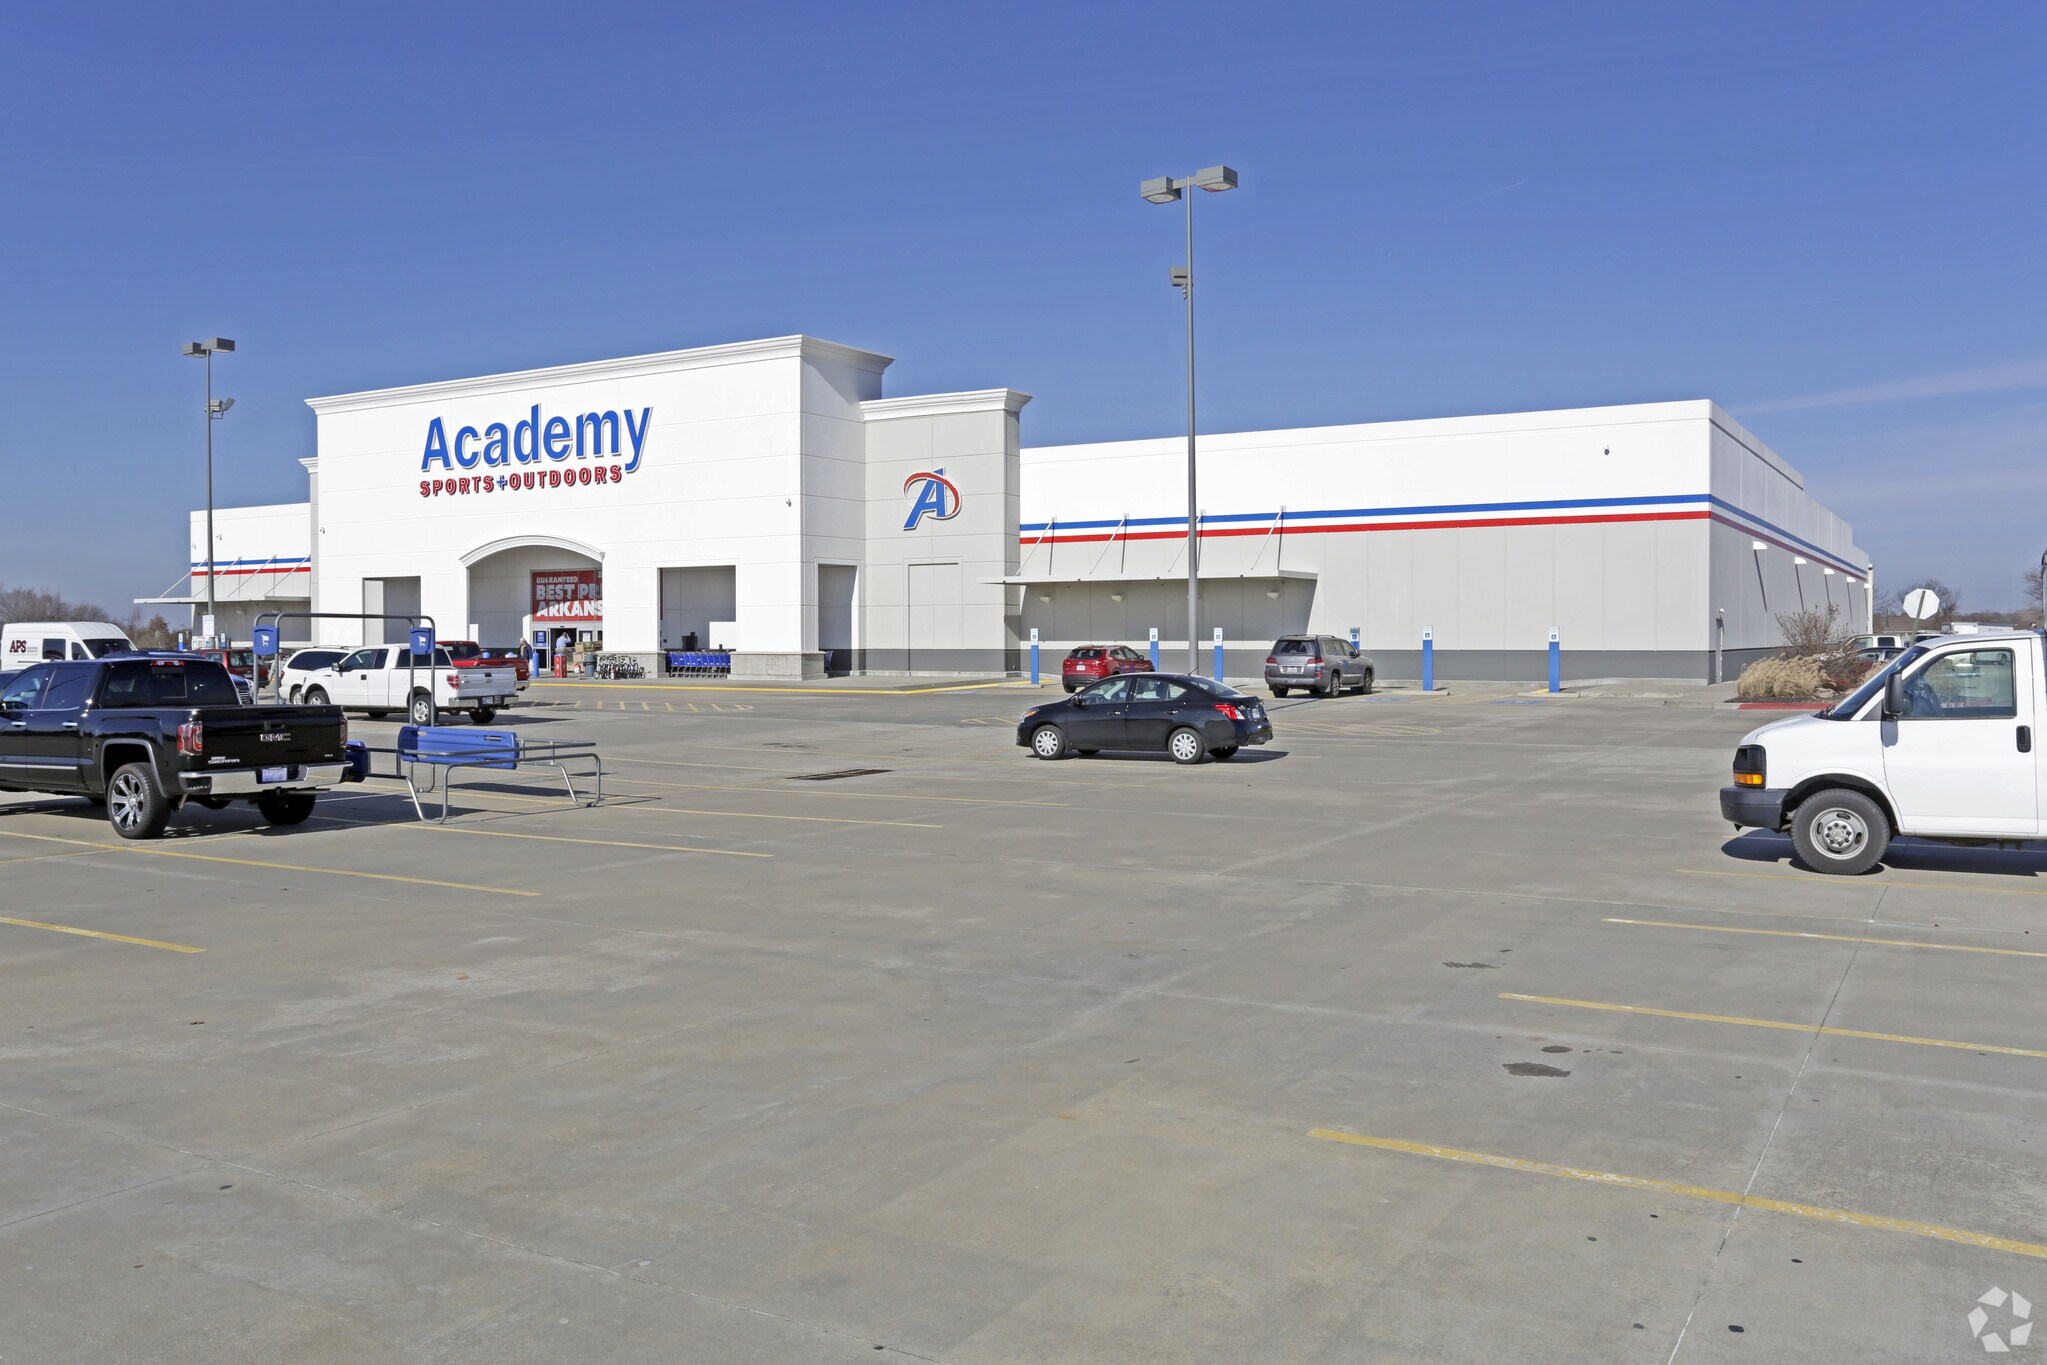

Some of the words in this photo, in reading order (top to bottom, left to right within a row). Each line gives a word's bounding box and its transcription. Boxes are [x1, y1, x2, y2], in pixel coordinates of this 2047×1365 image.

[420, 402, 652, 472] Academy
[536, 576, 578, 584] GUARANTEED
[536, 584, 575, 600] BEST
[9, 639, 27, 653] APS
[260, 733, 291, 742] GMC
